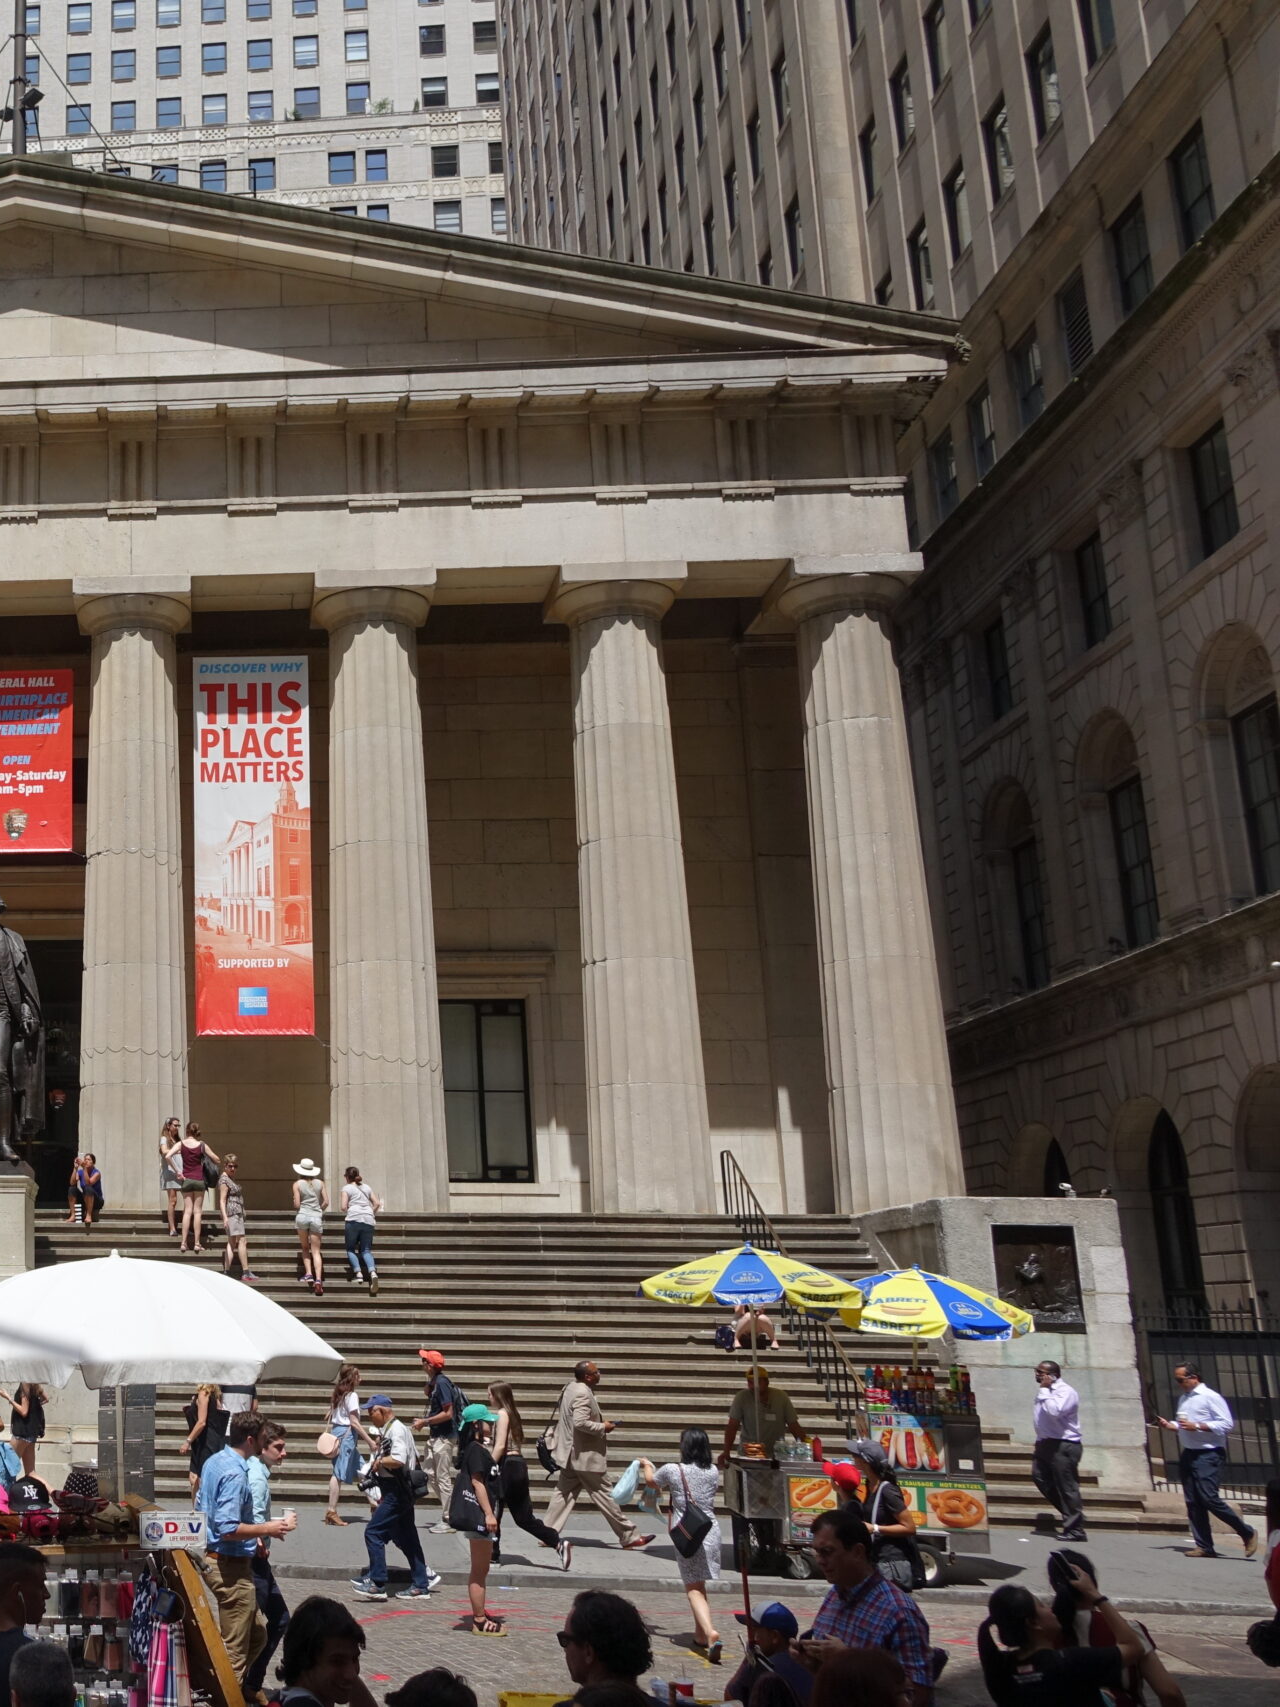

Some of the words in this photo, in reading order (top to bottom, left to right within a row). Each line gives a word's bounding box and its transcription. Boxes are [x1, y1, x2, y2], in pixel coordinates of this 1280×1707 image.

[200, 664, 266, 674] DISCOVER
[270, 662, 303, 672] WHY
[27, 677, 55, 687] HALL
[200, 681, 302, 724] THIS
[201, 727, 303, 758] PLACE
[2, 755, 31, 765] OPEN
[200, 760, 304, 783] MATTERS
[218, 958, 275, 968] SUPPORTED
[277, 958, 289, 968] BY
[664, 1269, 719, 1279] SABRETT
[654, 1289, 695, 1300] SABRETT
[861, 1319, 923, 1331] SABRETT
[22, 1484, 38, 1499] NY
[165, 1522, 202, 1533] DAV
